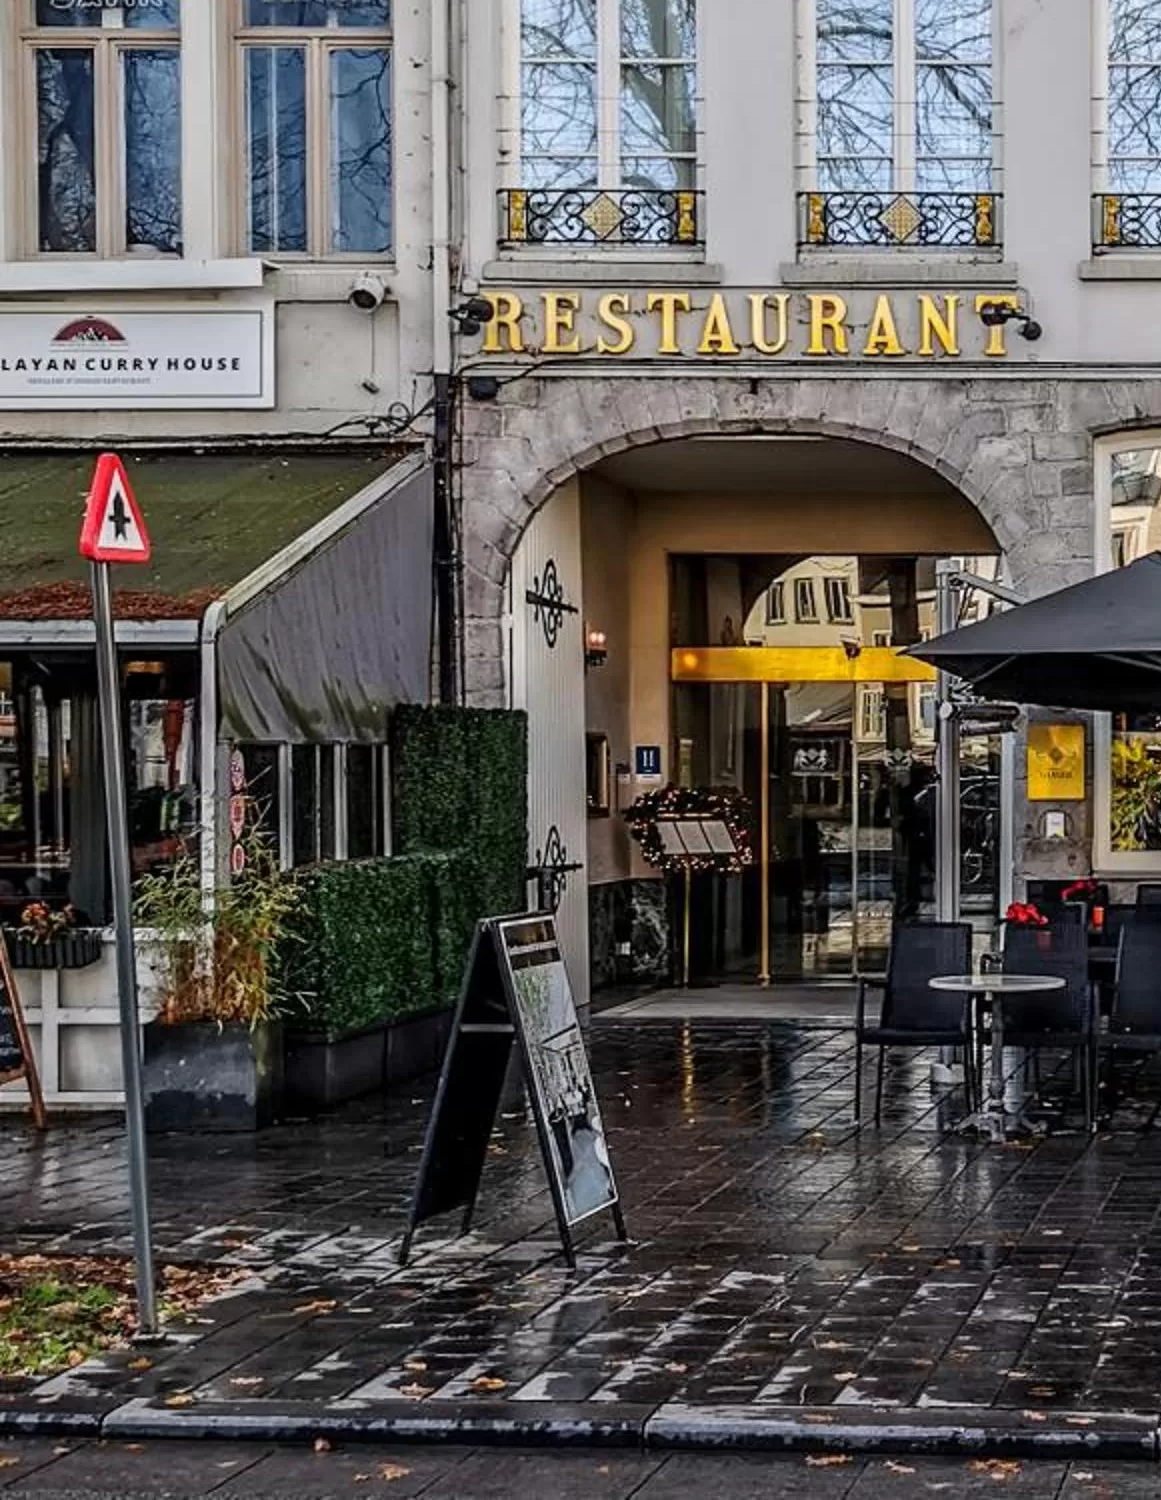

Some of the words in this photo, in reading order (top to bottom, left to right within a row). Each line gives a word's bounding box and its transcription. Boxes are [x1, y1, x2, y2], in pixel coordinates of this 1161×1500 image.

[482, 290, 1018, 356] RESTAURANT
[1, 357, 77, 371] LAYAN
[85, 357, 159, 371] CURRY
[167, 357, 241, 371] HOUSE
